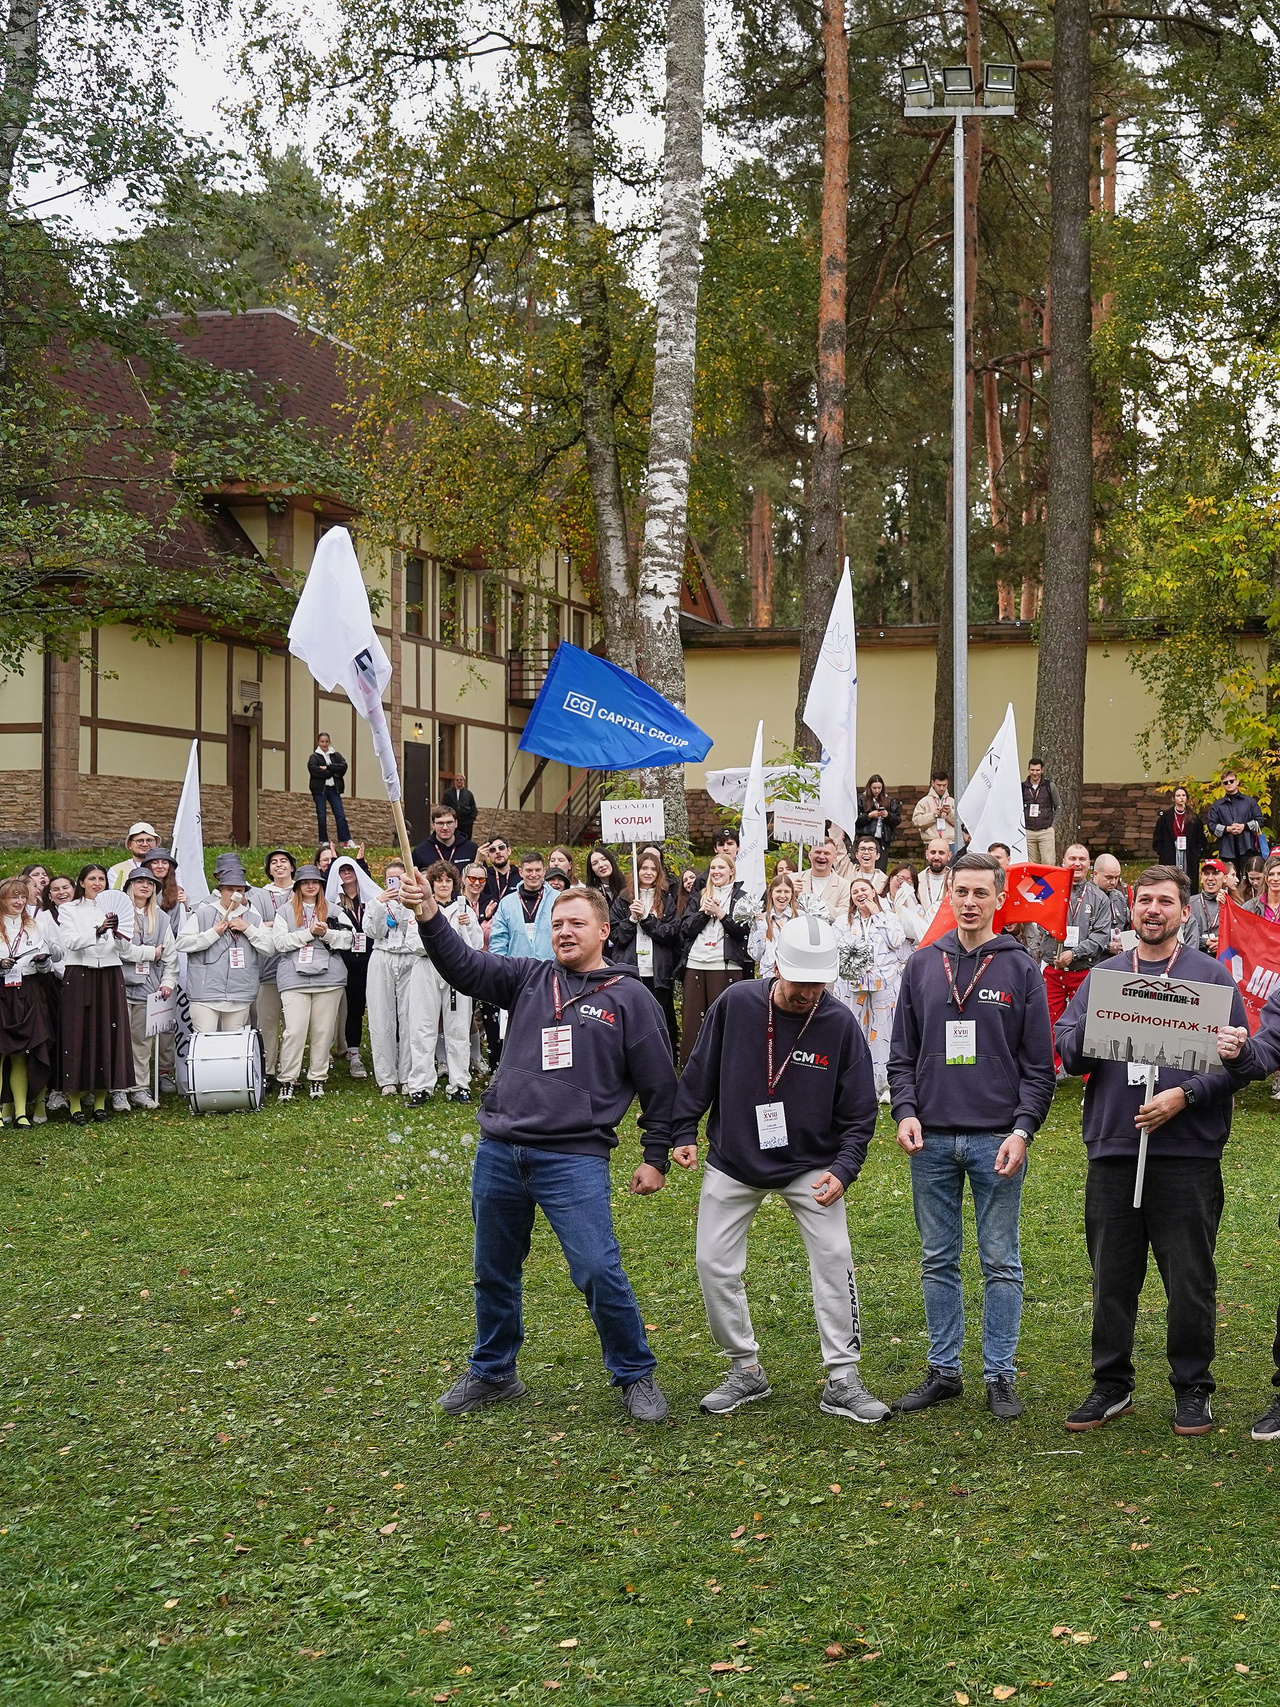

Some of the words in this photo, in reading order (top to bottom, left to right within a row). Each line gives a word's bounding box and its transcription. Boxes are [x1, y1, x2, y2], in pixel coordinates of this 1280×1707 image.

[570, 697, 591, 712] CG
[597, 708, 646, 735] CAPITAL
[648, 728, 689, 748] GROUP
[614, 816, 652, 825] КОЛДИ
[1121, 987, 1200, 1006] СТРОЙМОНТАЖ-14
[1096, 1009, 1200, 1032] СТРОЙМОНТАЖ
[1202, 1024, 1220, 1035] -14
